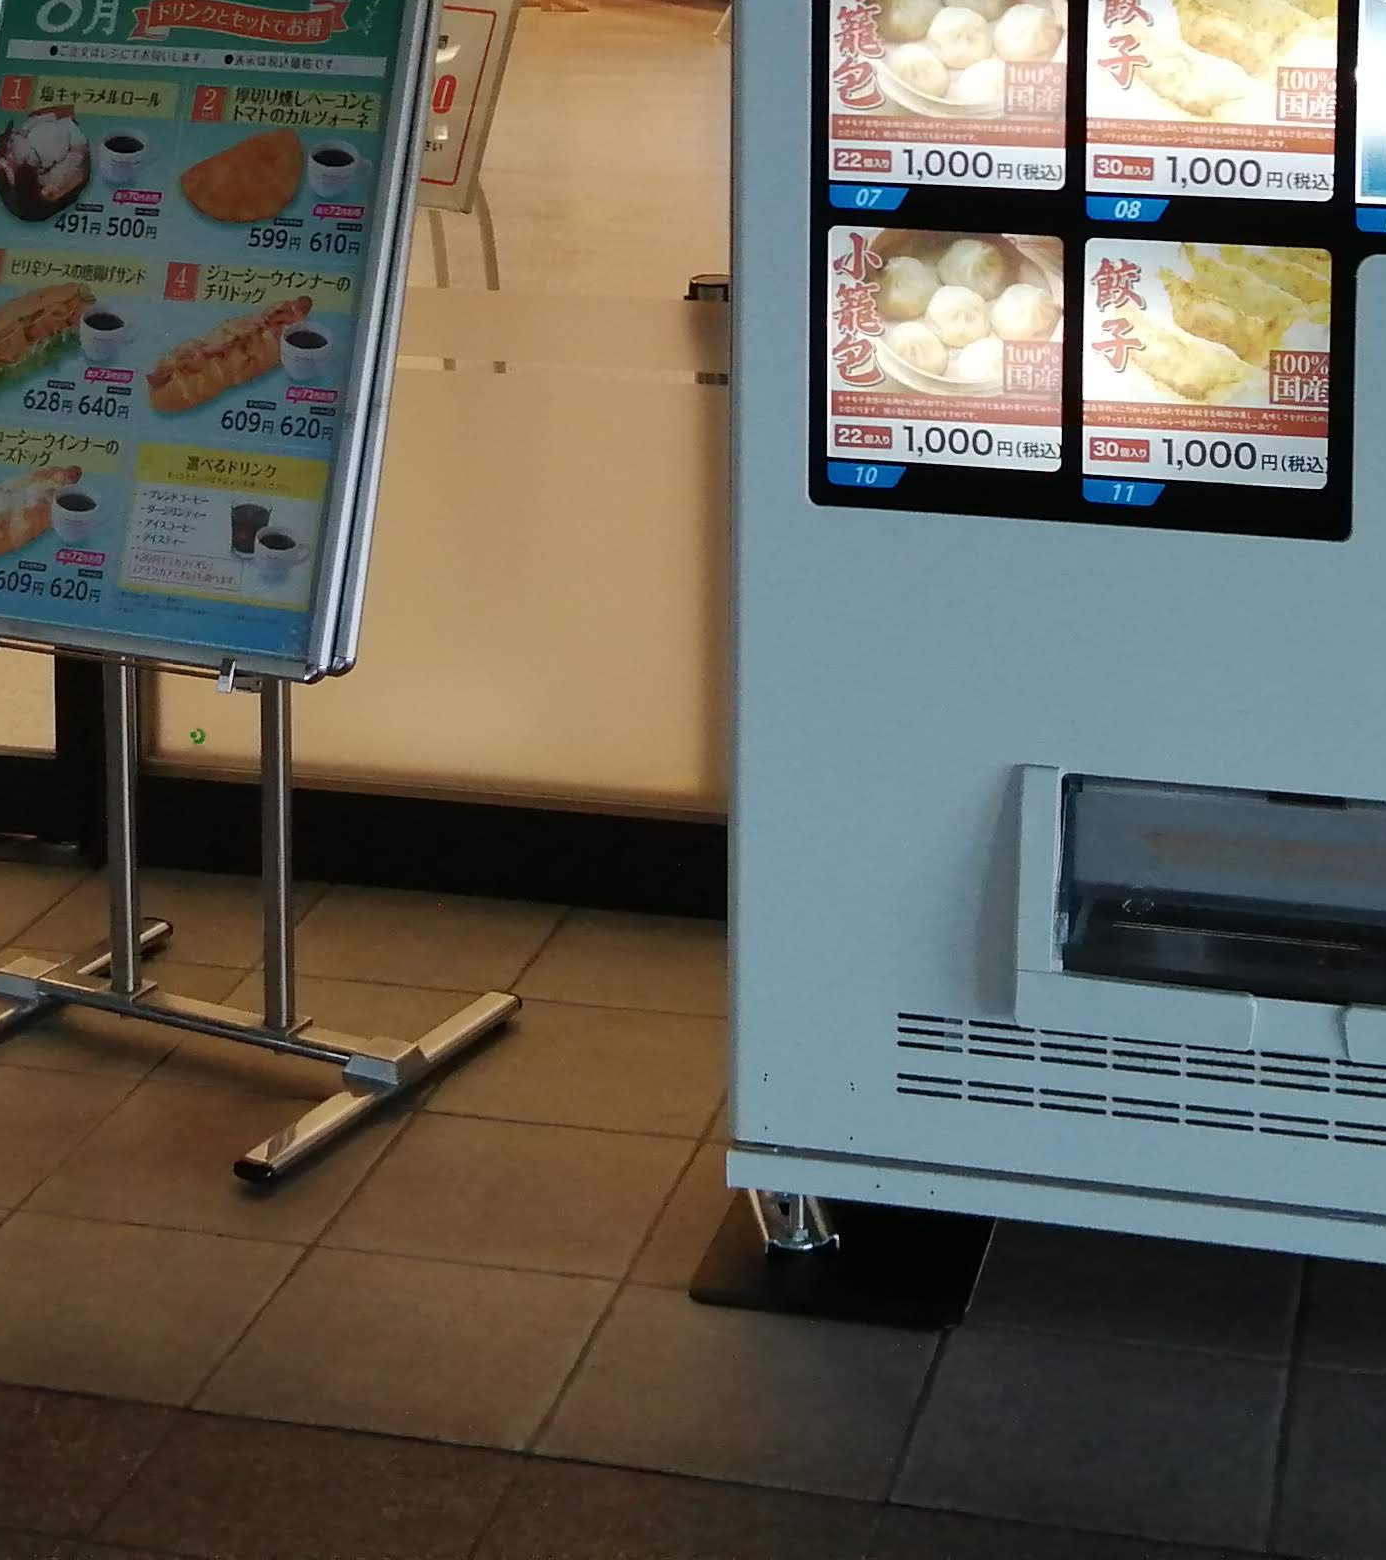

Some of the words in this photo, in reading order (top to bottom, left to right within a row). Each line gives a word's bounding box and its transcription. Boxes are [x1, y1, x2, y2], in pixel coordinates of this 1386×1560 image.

[155, 2, 324, 38] ドリンクとセットでお得
[10, 78, 22, 100] 1
[39, 85, 162, 107] 塩キャラメルロール
[203, 88, 217, 111] 2
[1007, 86, 1063, 114] 国産
[1279, 92, 1336, 120] 国産
[838, 151, 891, 170] 22個入り
[1096, 157, 1152, 177] 30個入り
[855, 188, 881, 207] 07
[1114, 200, 1142, 219] 08
[54, 213, 101, 235] 491円
[106, 217, 158, 240] 500円
[247, 227, 303, 252] 599円
[309, 232, 361, 256] 610円
[174, 266, 188, 289] 4
[205, 264, 352, 292] ジューシーウインナーの
[202, 284, 267, 305] チリドッグ
[832, 232, 885, 387] 小籠包
[1091, 257, 1147, 372] 餃子
[1272, 353, 1329, 375] 100%
[1006, 365, 1061, 391] 国産
[1271, 375, 1329, 404] 国産
[23, 390, 73, 414] 628円
[78, 395, 131, 420] 640円
[221, 410, 275, 435] 609円
[280, 415, 334, 441] 620円
[838, 427, 891, 446] 22個入り
[1093, 440, 1147, 458] 30個入り
[185, 454, 278, 479] 選べるドリンク
[854, 466, 878, 485] 10
[1112, 483, 1134, 502] 11
[49, 576, 102, 603] 620円
